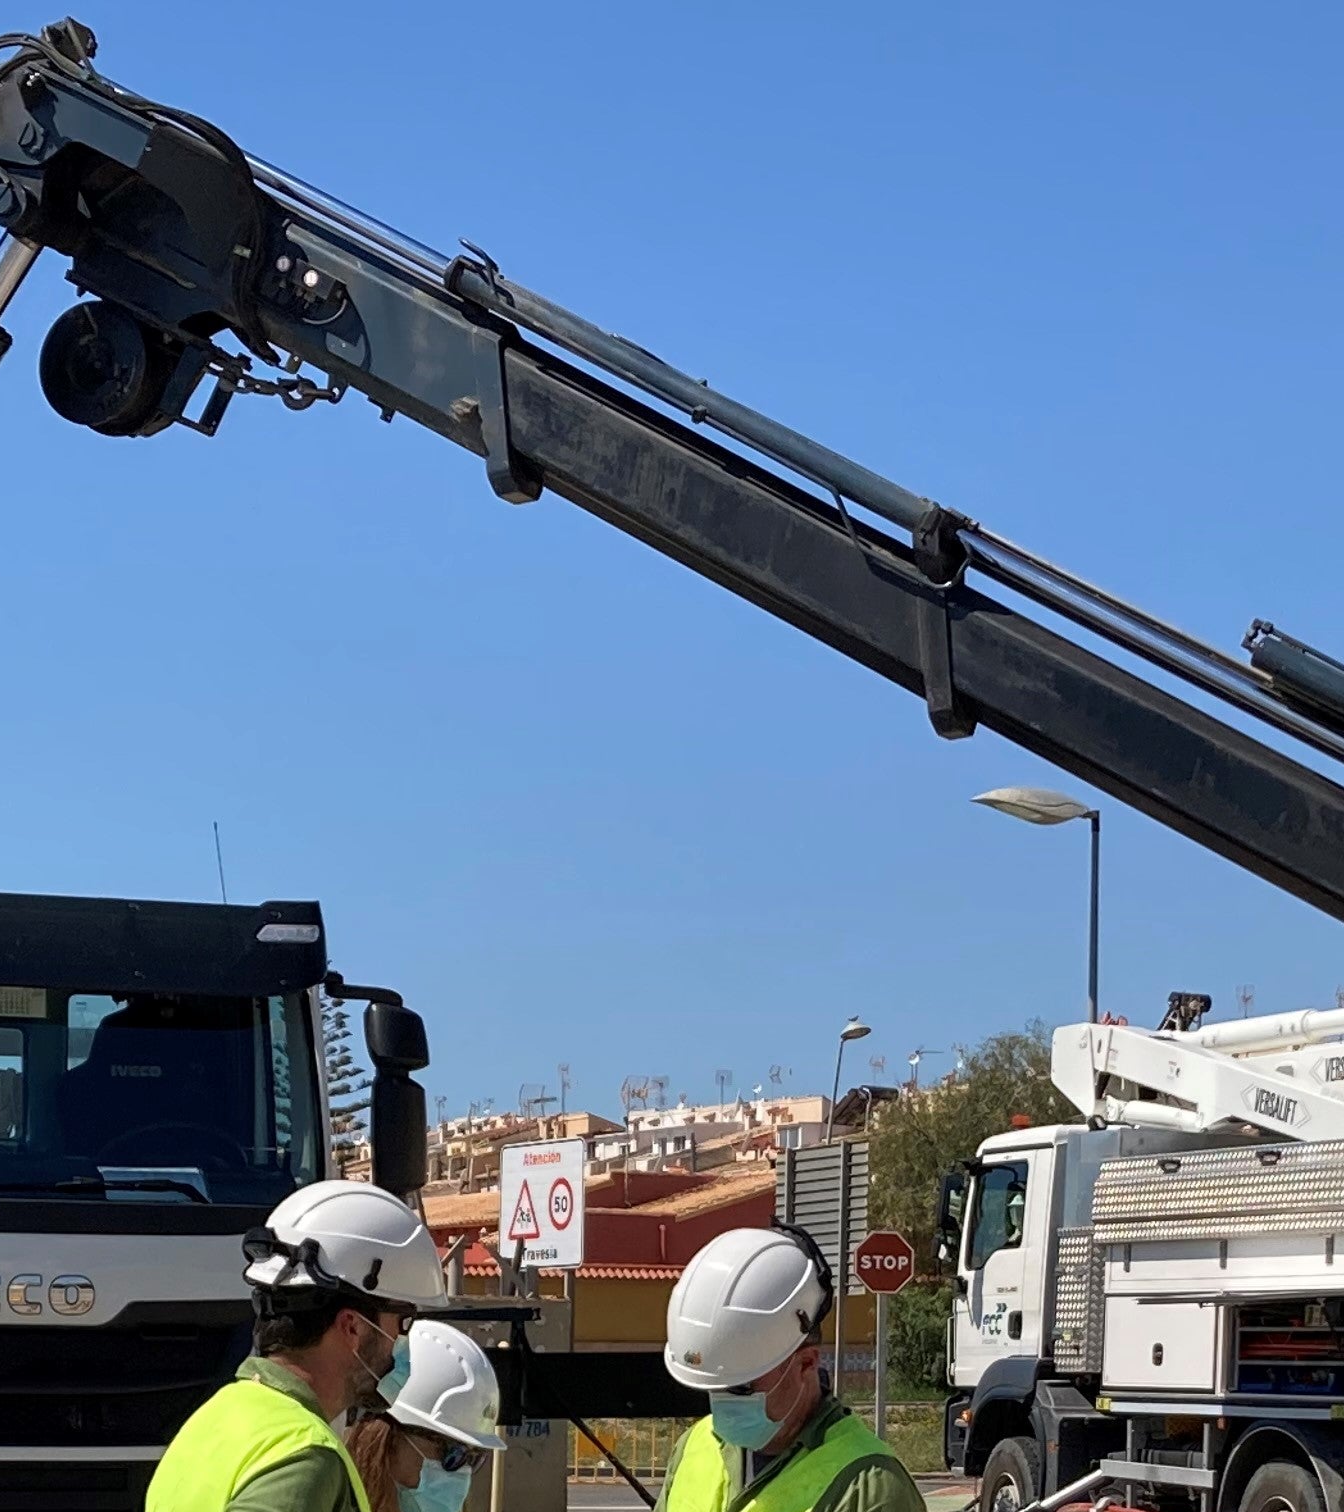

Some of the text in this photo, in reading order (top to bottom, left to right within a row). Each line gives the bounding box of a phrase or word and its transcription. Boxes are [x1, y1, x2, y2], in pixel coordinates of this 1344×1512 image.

[110, 1064, 162, 1077] IVECO
[1254, 1087, 1298, 1126] VERSALIFT
[554, 1195, 568, 1213] 50
[860, 1254, 909, 1270] STOP
